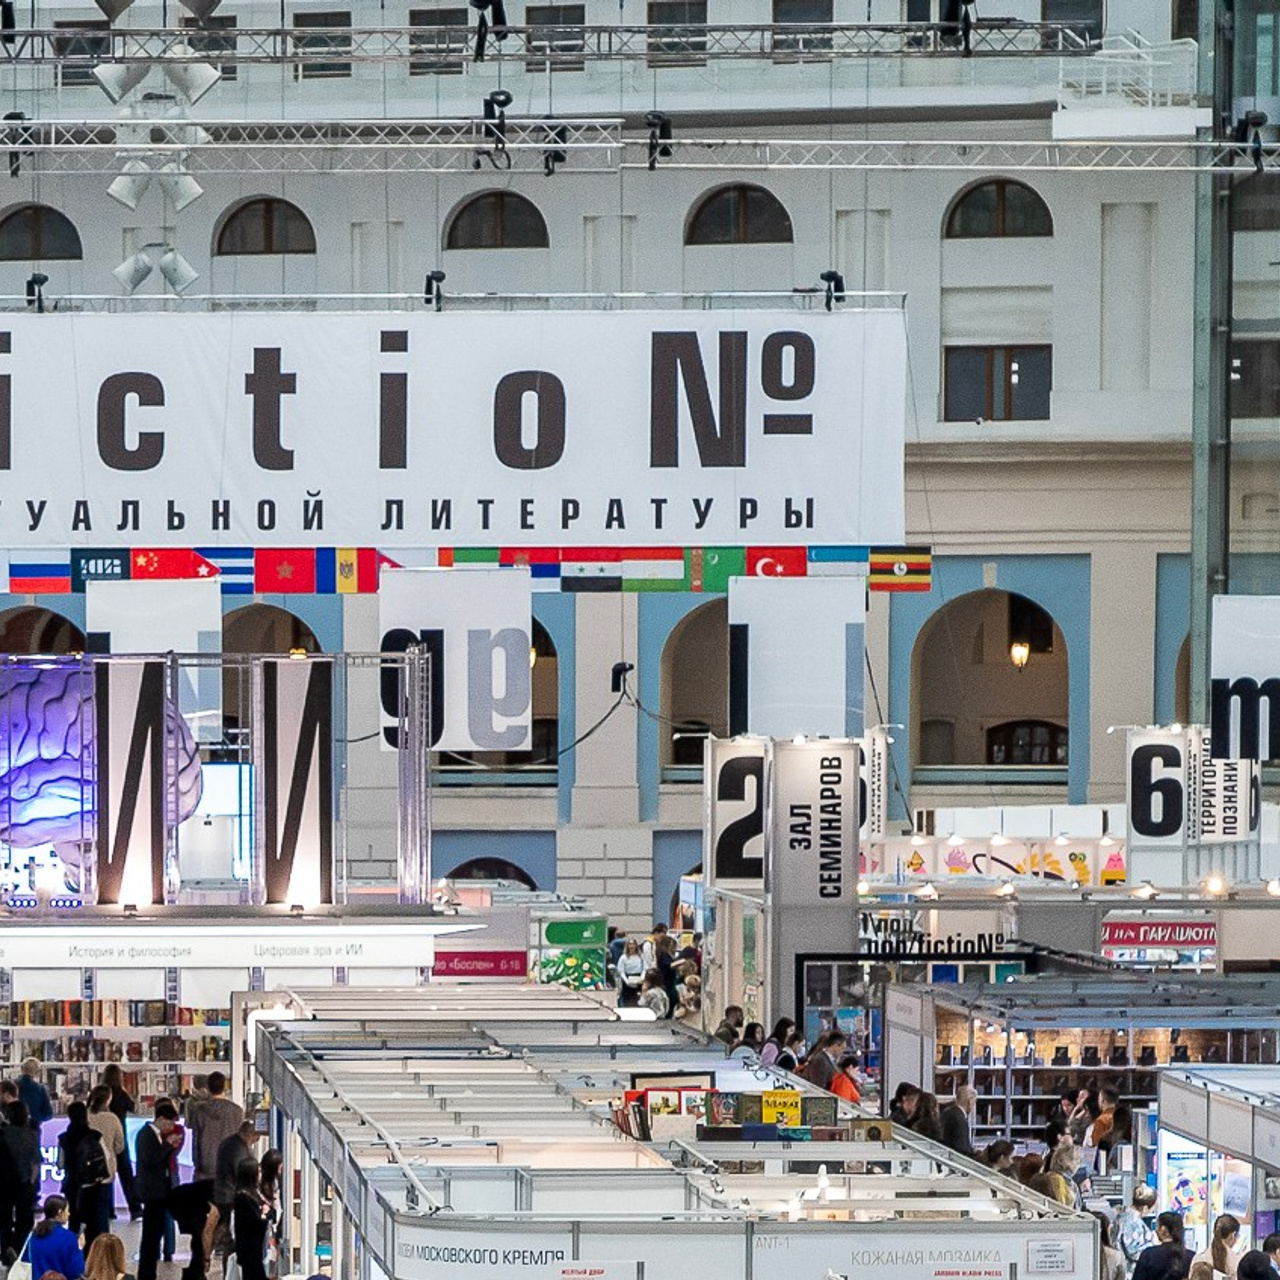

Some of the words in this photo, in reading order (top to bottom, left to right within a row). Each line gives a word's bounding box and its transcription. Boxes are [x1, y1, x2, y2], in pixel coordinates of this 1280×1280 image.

[381, 496, 815, 530] ЛИТЕРАТУРЫ
[1131, 744, 1183, 837] 6
[1223, 762, 1238, 835] ПОЗНАНИ
[716, 756, 764, 878] 2
[789, 804, 811, 850] ЗАЛ
[820, 756, 841, 898] СЕМИНАРОВ
[69, 946, 114, 959] История
[128, 947, 192, 959] философия
[254, 944, 309, 958] Цифровая
[346, 944, 363, 955] ИИ
[416, 1246, 498, 1265] МОСКОВСКОГО
[503, 1250, 565, 1265] КРЕМЛЯ
[851, 1251, 923, 1266] КОЖАНАЯ
